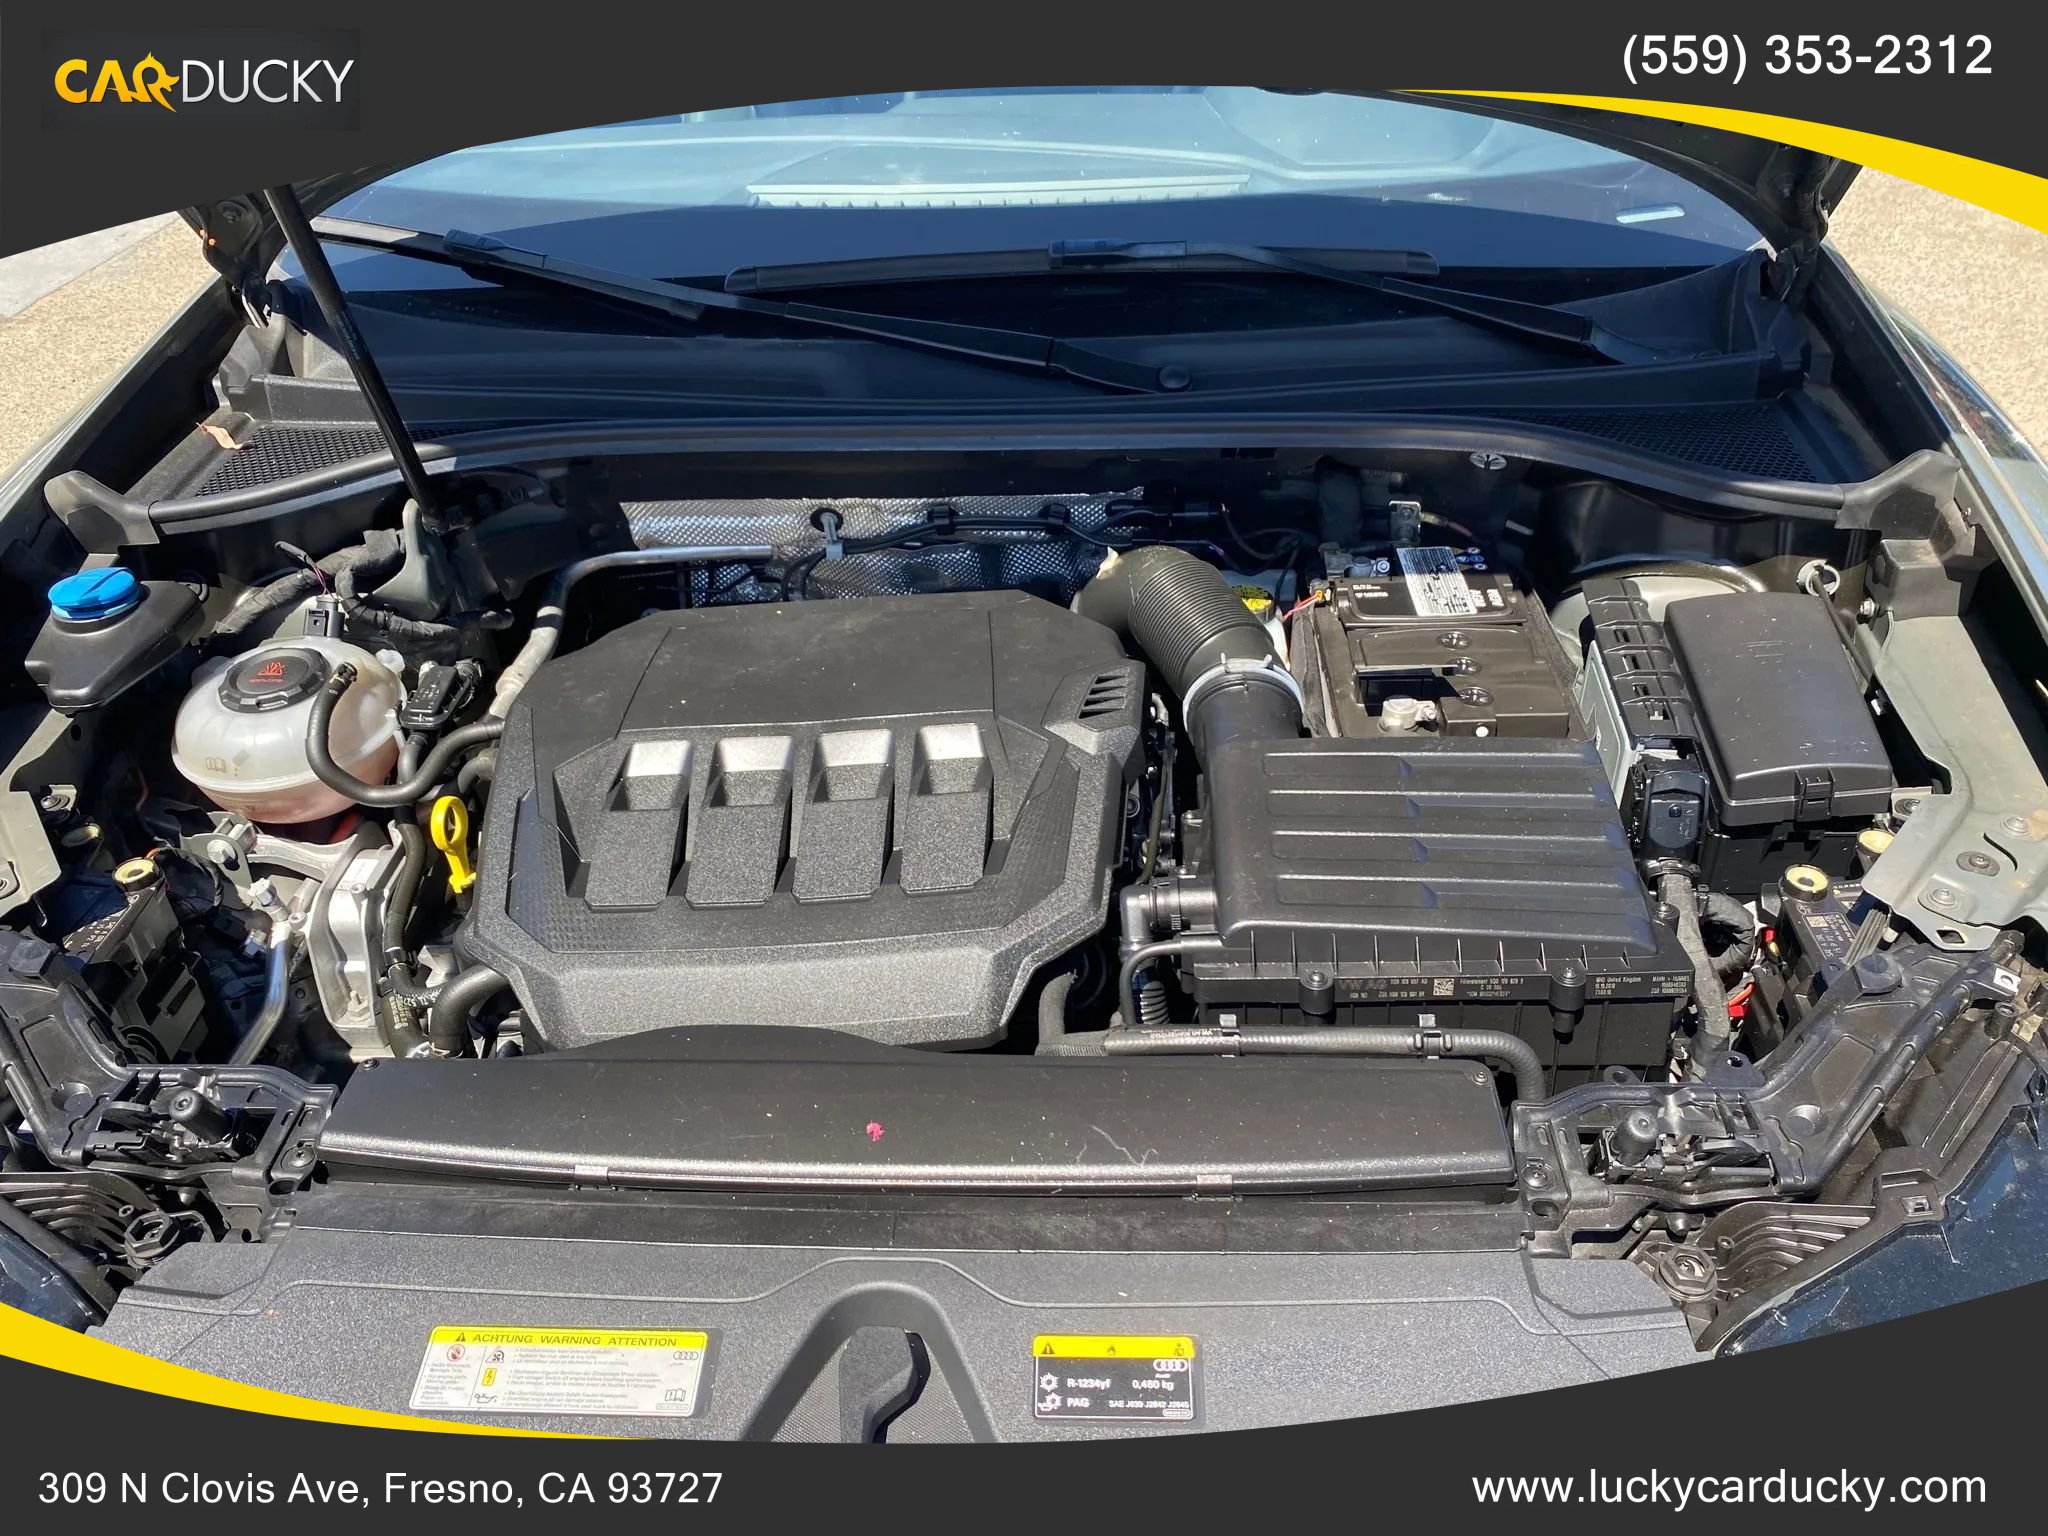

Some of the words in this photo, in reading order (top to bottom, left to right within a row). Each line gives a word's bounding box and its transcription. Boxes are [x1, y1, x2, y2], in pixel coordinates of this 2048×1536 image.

[472, 1334, 533, 1344] ACHTUNG
[540, 1335, 601, 1345] WARNING
[608, 1336, 677, 1347] ATTENTION
[1066, 1377, 1111, 1390] R-1234yf
[1161, 1379, 1175, 1391] kg
[1066, 1397, 1090, 1408] PAG
[1108, 1400, 1125, 1408] SAE
